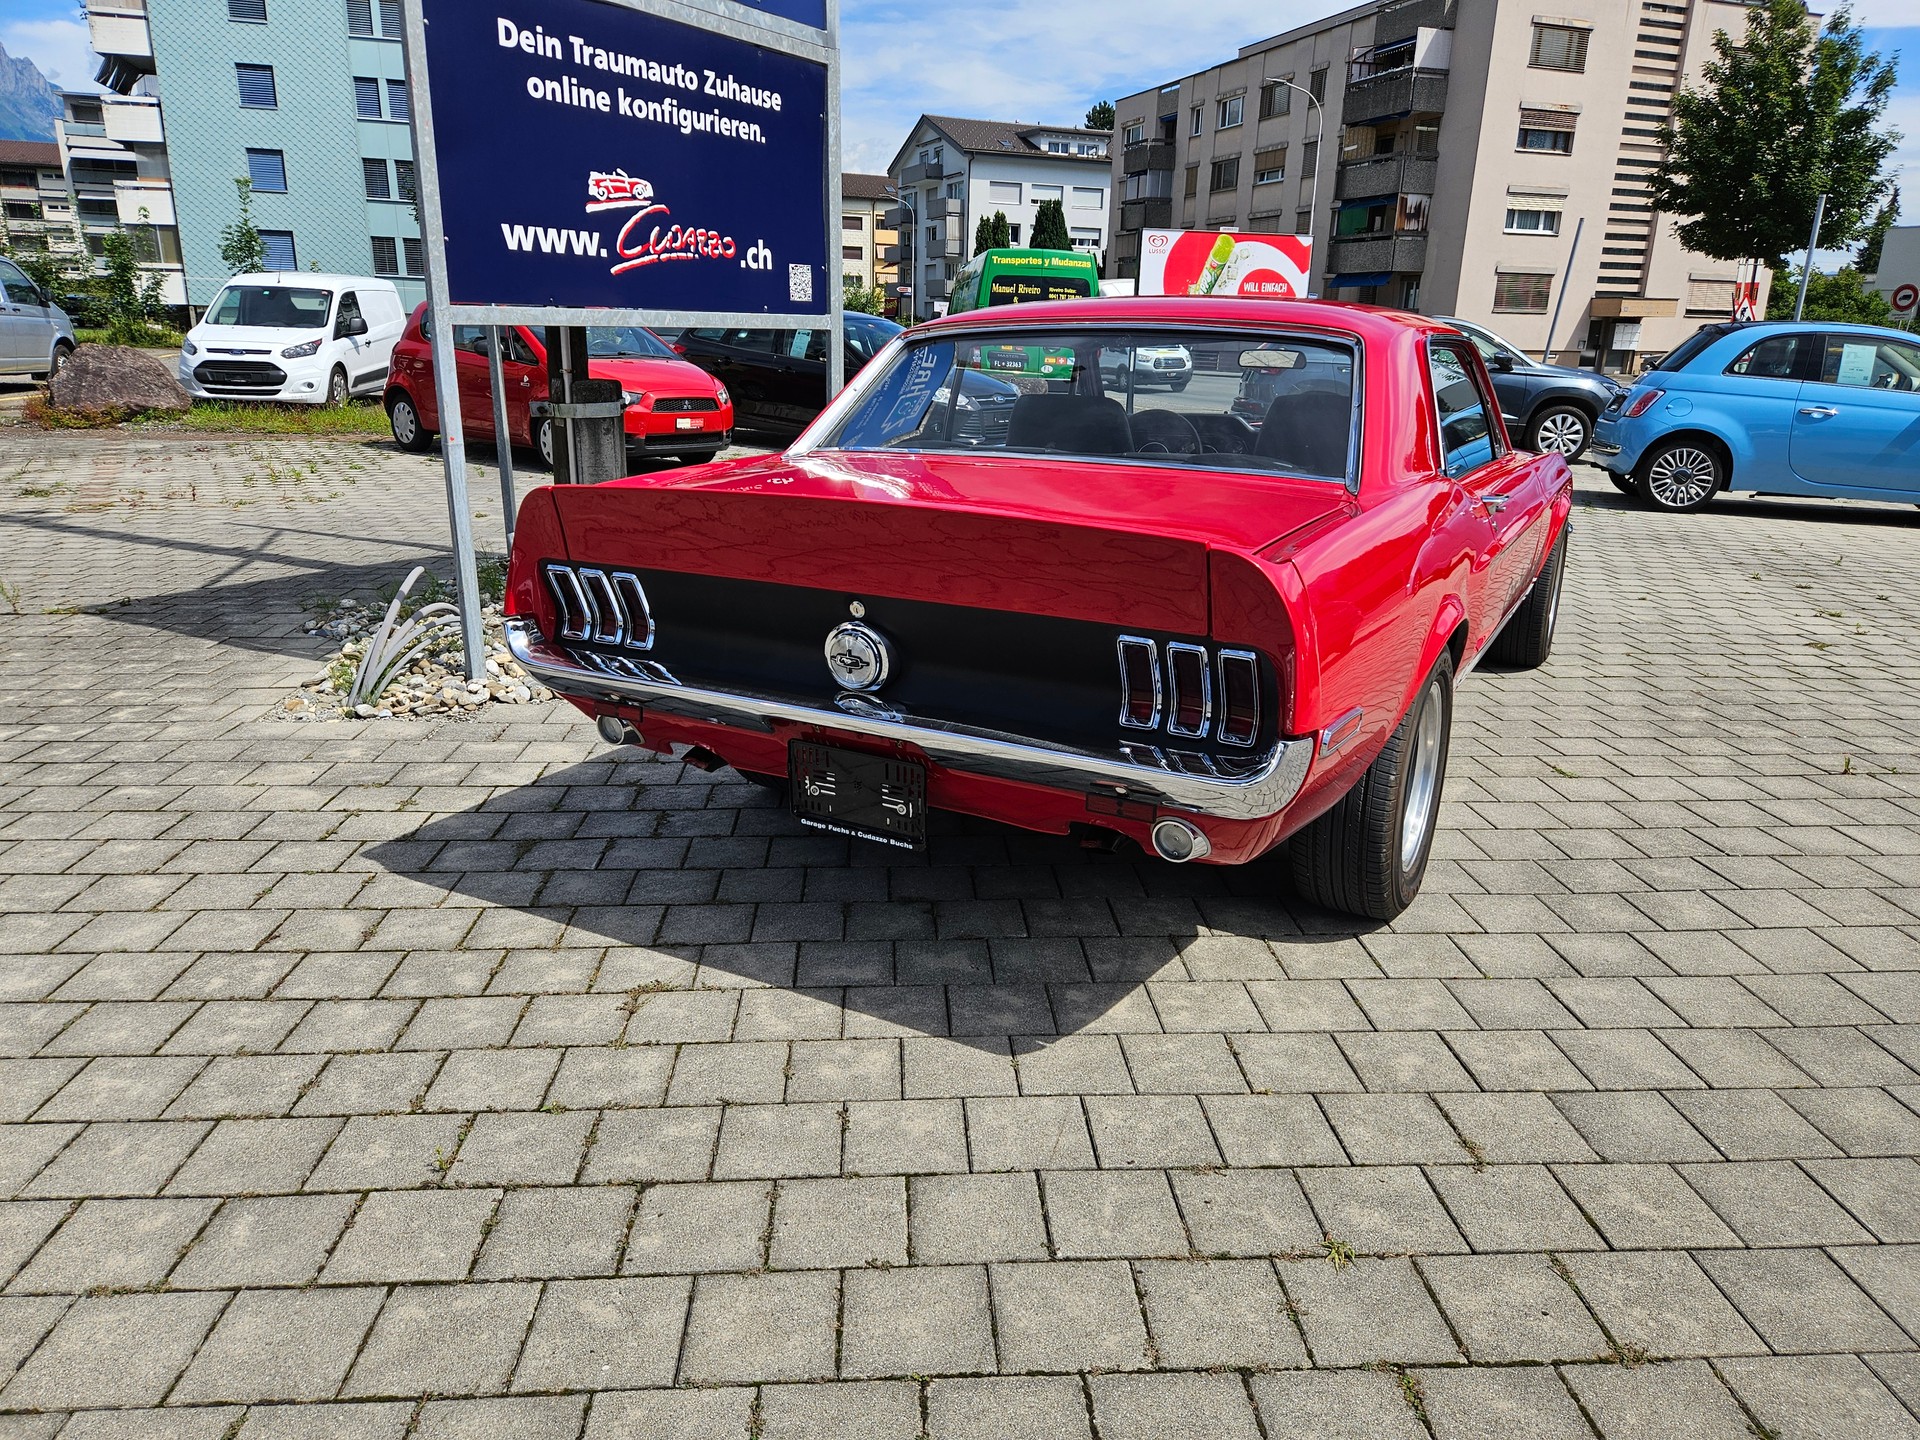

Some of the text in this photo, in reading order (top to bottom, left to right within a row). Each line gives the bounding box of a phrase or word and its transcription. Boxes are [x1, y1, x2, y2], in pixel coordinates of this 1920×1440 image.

[497, 17, 782, 111] Dein Traumauto Zuhause
[527, 75, 766, 143] online konfigurieren.
[992, 255, 1091, 268] Transportes y Mudanzas
[992, 283, 1041, 295] Manuel Riveiro
[1243, 282, 1288, 293] WILL EINFACH
[800, 818, 826, 830] Garage
[828, 824, 850, 835] Fuchs
[857, 831, 887, 844] Cudazzo
[890, 839, 913, 850] Buchs
